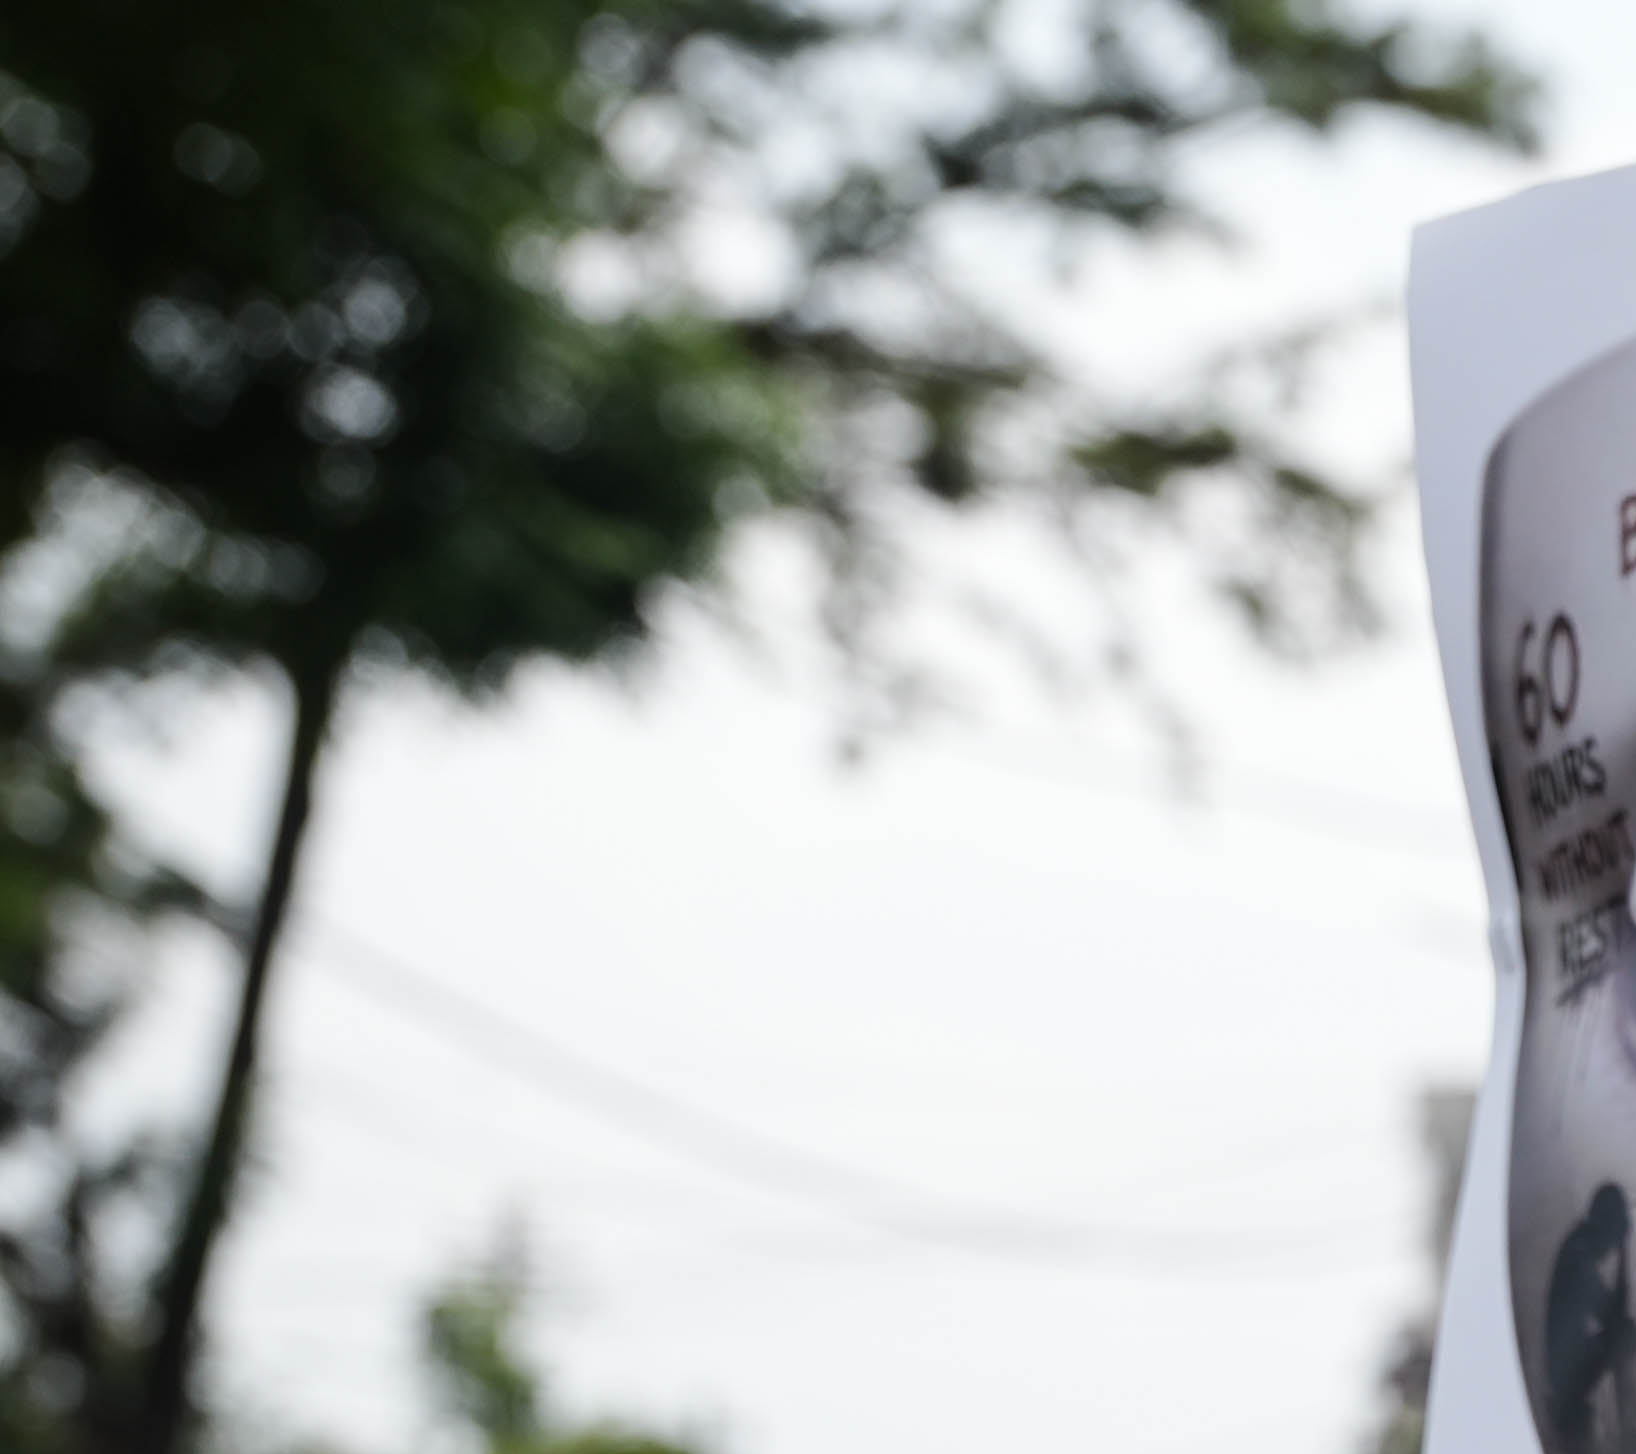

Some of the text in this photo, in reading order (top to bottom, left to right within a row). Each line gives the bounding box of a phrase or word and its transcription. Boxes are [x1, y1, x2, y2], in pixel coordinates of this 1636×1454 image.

[1515, 612, 1580, 750] 60
[1526, 737, 1608, 828] HOURS
[1538, 807, 1636, 902] WITHOUT
